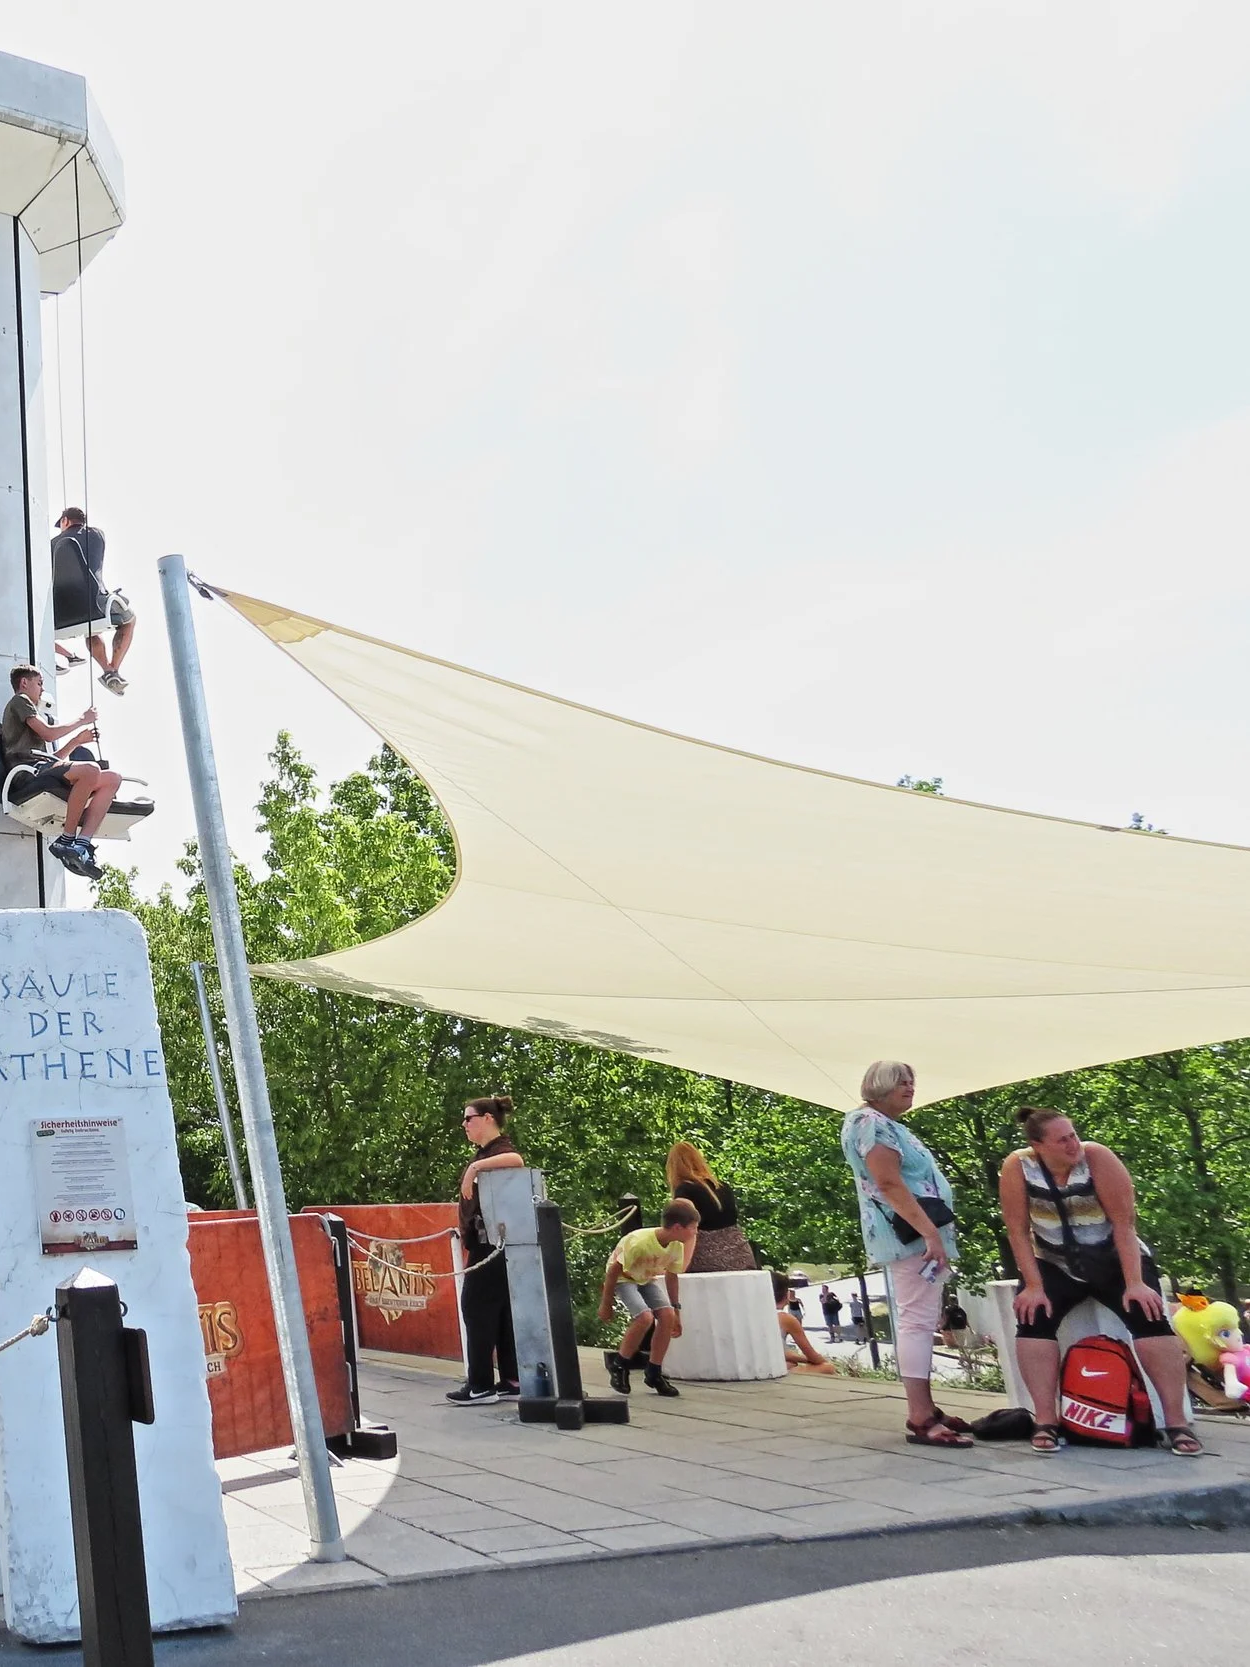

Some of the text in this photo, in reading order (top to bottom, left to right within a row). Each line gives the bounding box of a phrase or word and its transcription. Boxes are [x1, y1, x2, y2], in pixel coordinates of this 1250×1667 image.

[29, 1011, 103, 1037] DER
[41, 1118, 117, 1129] Sicherheitshinweise
[1064, 1402, 1117, 1429] NIKE
